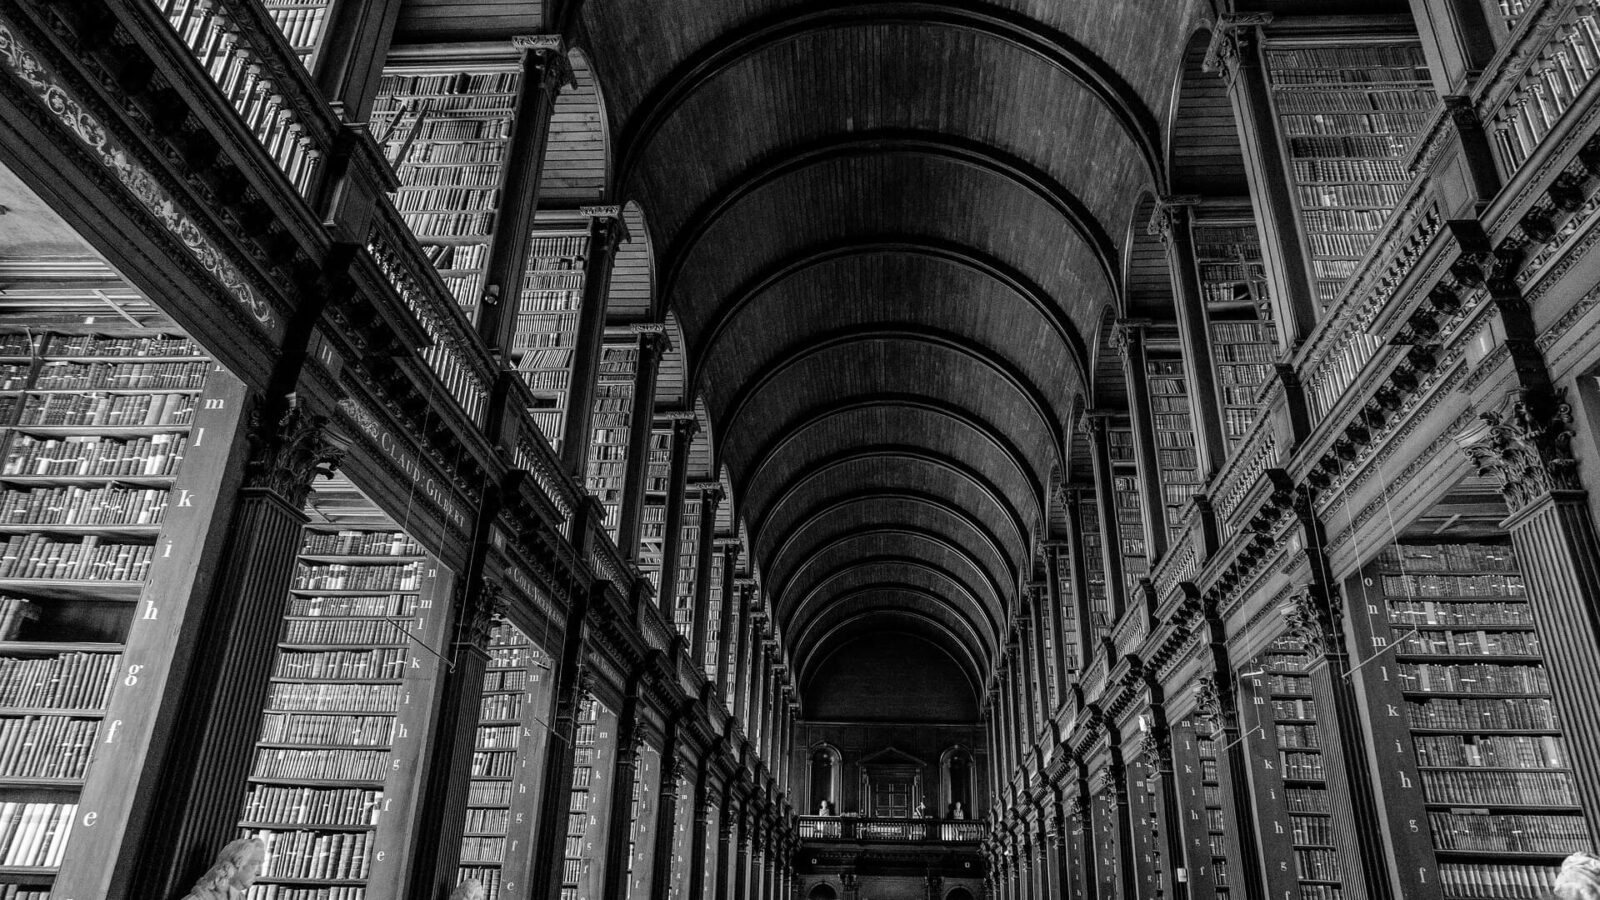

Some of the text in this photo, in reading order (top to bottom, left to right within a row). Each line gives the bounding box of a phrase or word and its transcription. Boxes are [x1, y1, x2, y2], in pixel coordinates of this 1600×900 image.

[205, 399, 224, 409] m
[194, 428, 204, 446] l
[178, 490, 194, 506] k
[427, 479, 465, 527] GILBERT
[162, 540, 172, 557] i
[1365, 578, 1372, 586] o
[420, 600, 432, 608] m
[1368, 604, 1378, 614] n
[143, 601, 157, 619] h
[418, 618, 423, 629] l
[1372, 636, 1386, 646] m
[412, 658, 420, 668] k
[125, 665, 143, 686] g
[1382, 667, 1388, 680] l
[405, 692, 409, 704] i
[528, 694, 531, 703] l
[1387, 704, 1399, 716] k
[105, 720, 122, 743] f
[399, 724, 407, 737] h
[524, 728, 530, 736] k
[1260, 729, 1265, 739] l
[1396, 740, 1402, 752] i
[393, 760, 400, 768] g
[523, 757, 525, 767] i
[1265, 760, 1272, 769] k
[1400, 772, 1411, 788] h
[520, 784, 525, 793] h
[1271, 789, 1275, 799] i
[384, 799, 392, 811] f
[84, 812, 97, 826] e
[516, 813, 522, 822] g
[1274, 821, 1283, 833] h
[1409, 820, 1418, 832] g
[512, 840, 518, 851] f
[377, 851, 384, 861] e
[1420, 868, 1426, 882] f
[507, 882, 514, 890] e
